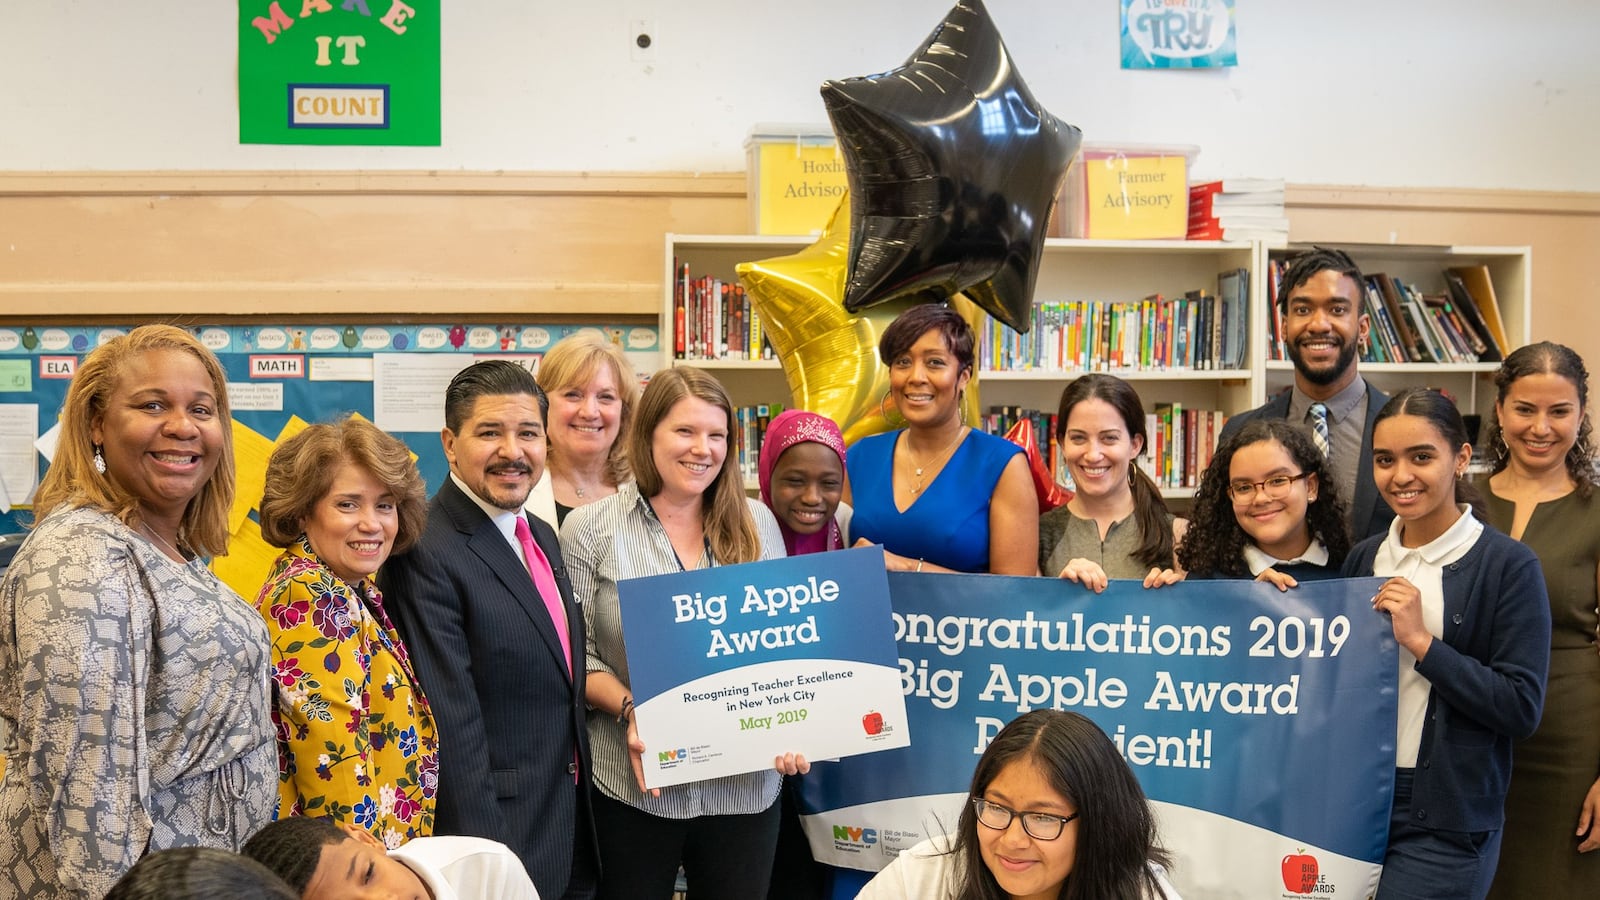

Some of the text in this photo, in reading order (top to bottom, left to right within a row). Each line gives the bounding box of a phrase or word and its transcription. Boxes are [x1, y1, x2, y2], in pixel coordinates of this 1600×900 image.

[315, 35, 366, 66] IT
[297, 96, 381, 116] COUNT
[1118, 171, 1166, 184] Farmer
[784, 182, 848, 198] Adviso
[1103, 192, 1173, 208] Advisory
[47, 362, 70, 373] ELA
[257, 360, 297, 371] MATH
[672, 576, 840, 625] Big Apple
[706, 615, 821, 658] Award
[892, 610, 1351, 658] ongratulations 2019
[683, 670, 853, 703] Recognizing Teacher Excellence
[898, 658, 1300, 715] Big Apple Award
[726, 690, 815, 712] in New York City
[739, 708, 808, 731] May 2019
[973, 716, 1212, 769] Rient!
[658, 748, 687, 761] NYC
[833, 825, 877, 844] NYC
[1302, 864, 1315, 873] BIG
[1302, 874, 1326, 883] APPLE
[1301, 884, 1335, 893] AWARDS
